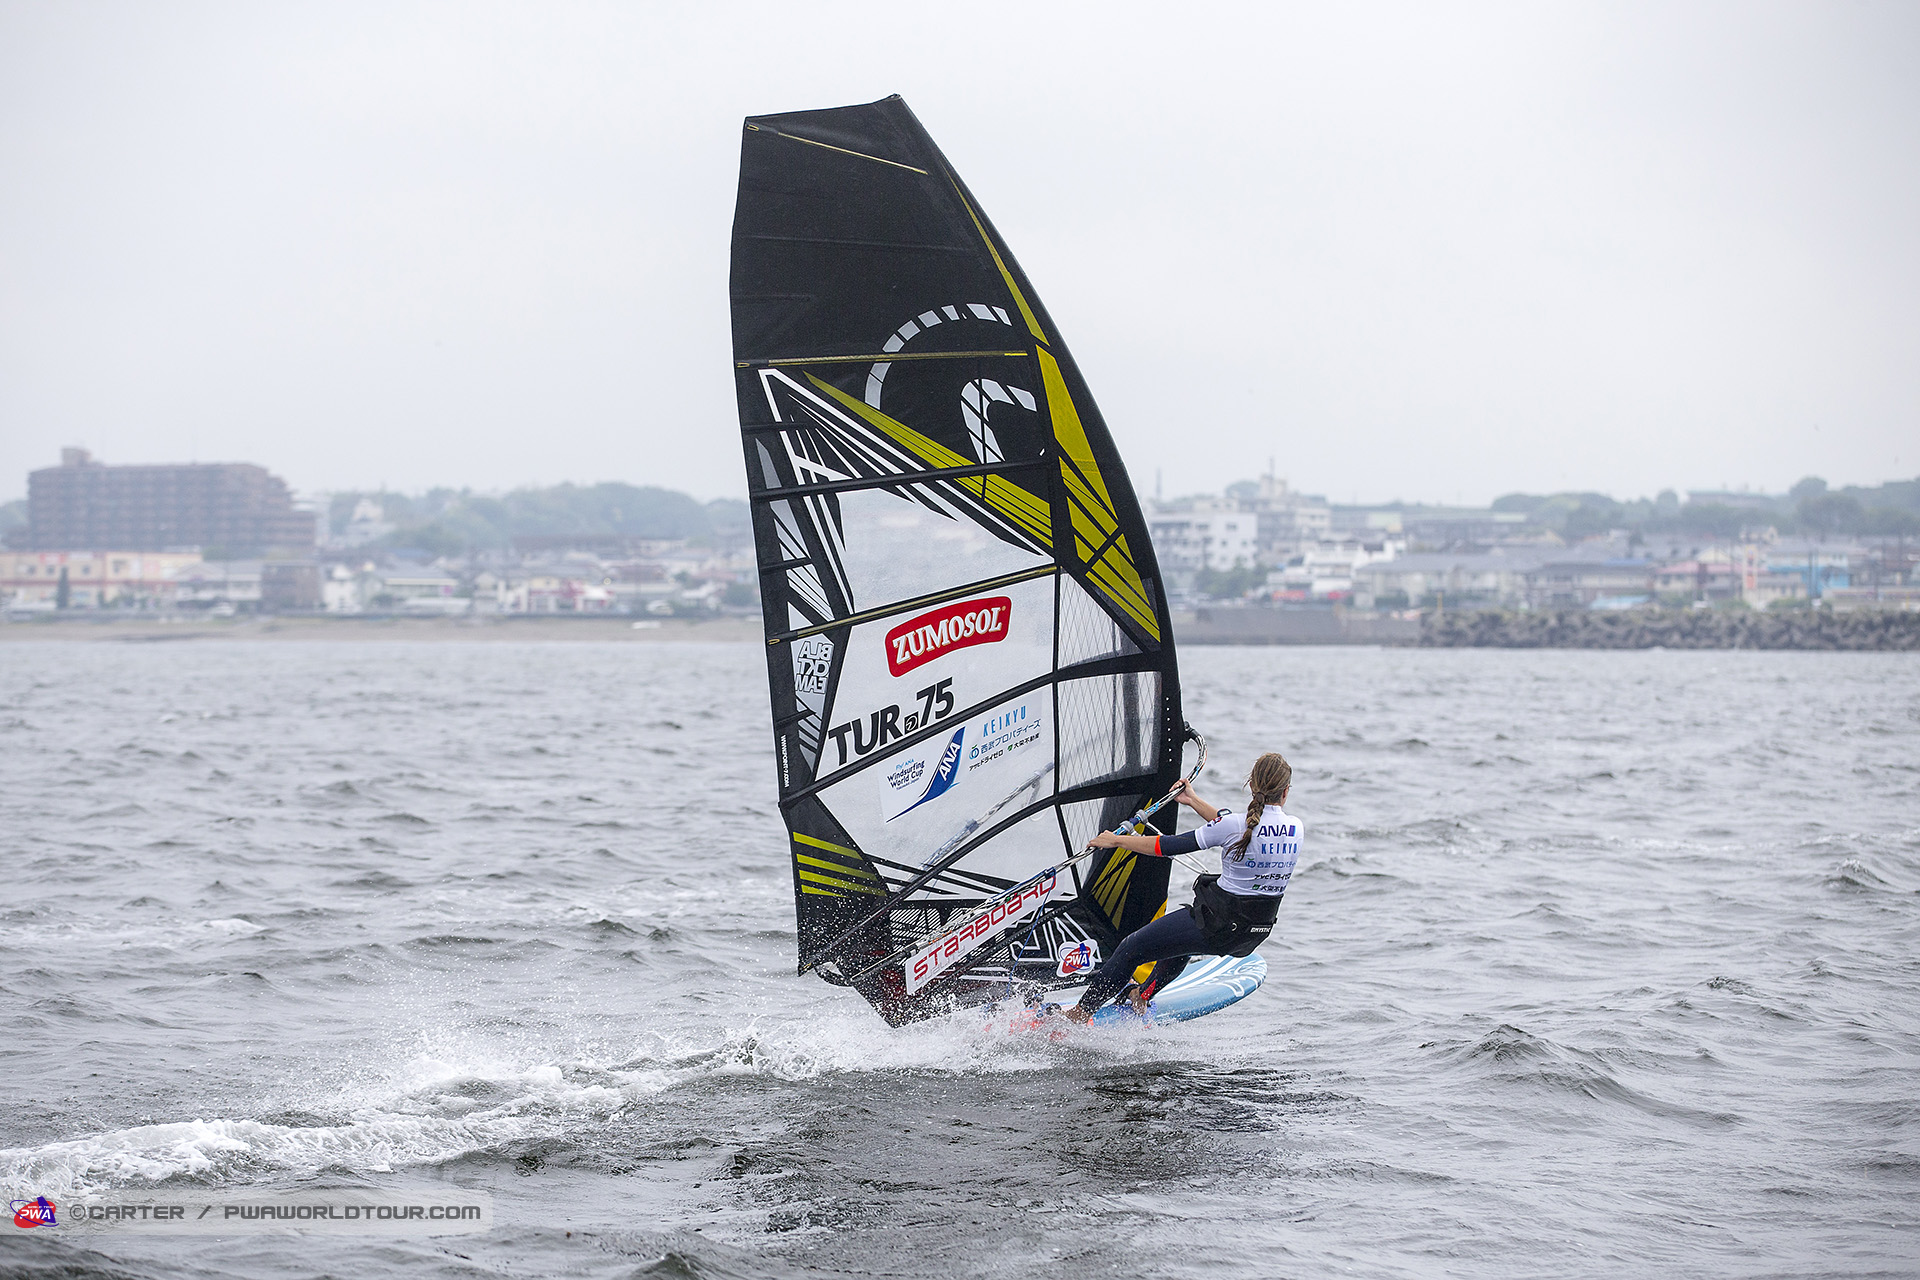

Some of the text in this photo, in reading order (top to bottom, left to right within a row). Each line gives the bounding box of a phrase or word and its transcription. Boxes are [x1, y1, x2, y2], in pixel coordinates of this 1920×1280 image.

[892, 607, 1003, 666] ZUMOSOL
[828, 677, 954, 766] TUR 75
[983, 705, 1026, 738] KEIKYU
[887, 760, 925, 782] Windsurfing
[939, 742, 961, 781] ANA
[890, 774, 910, 788] World
[911, 769, 924, 780] Cup
[1257, 825, 1288, 837] ANA
[1066, 953, 1088, 967] PWA
